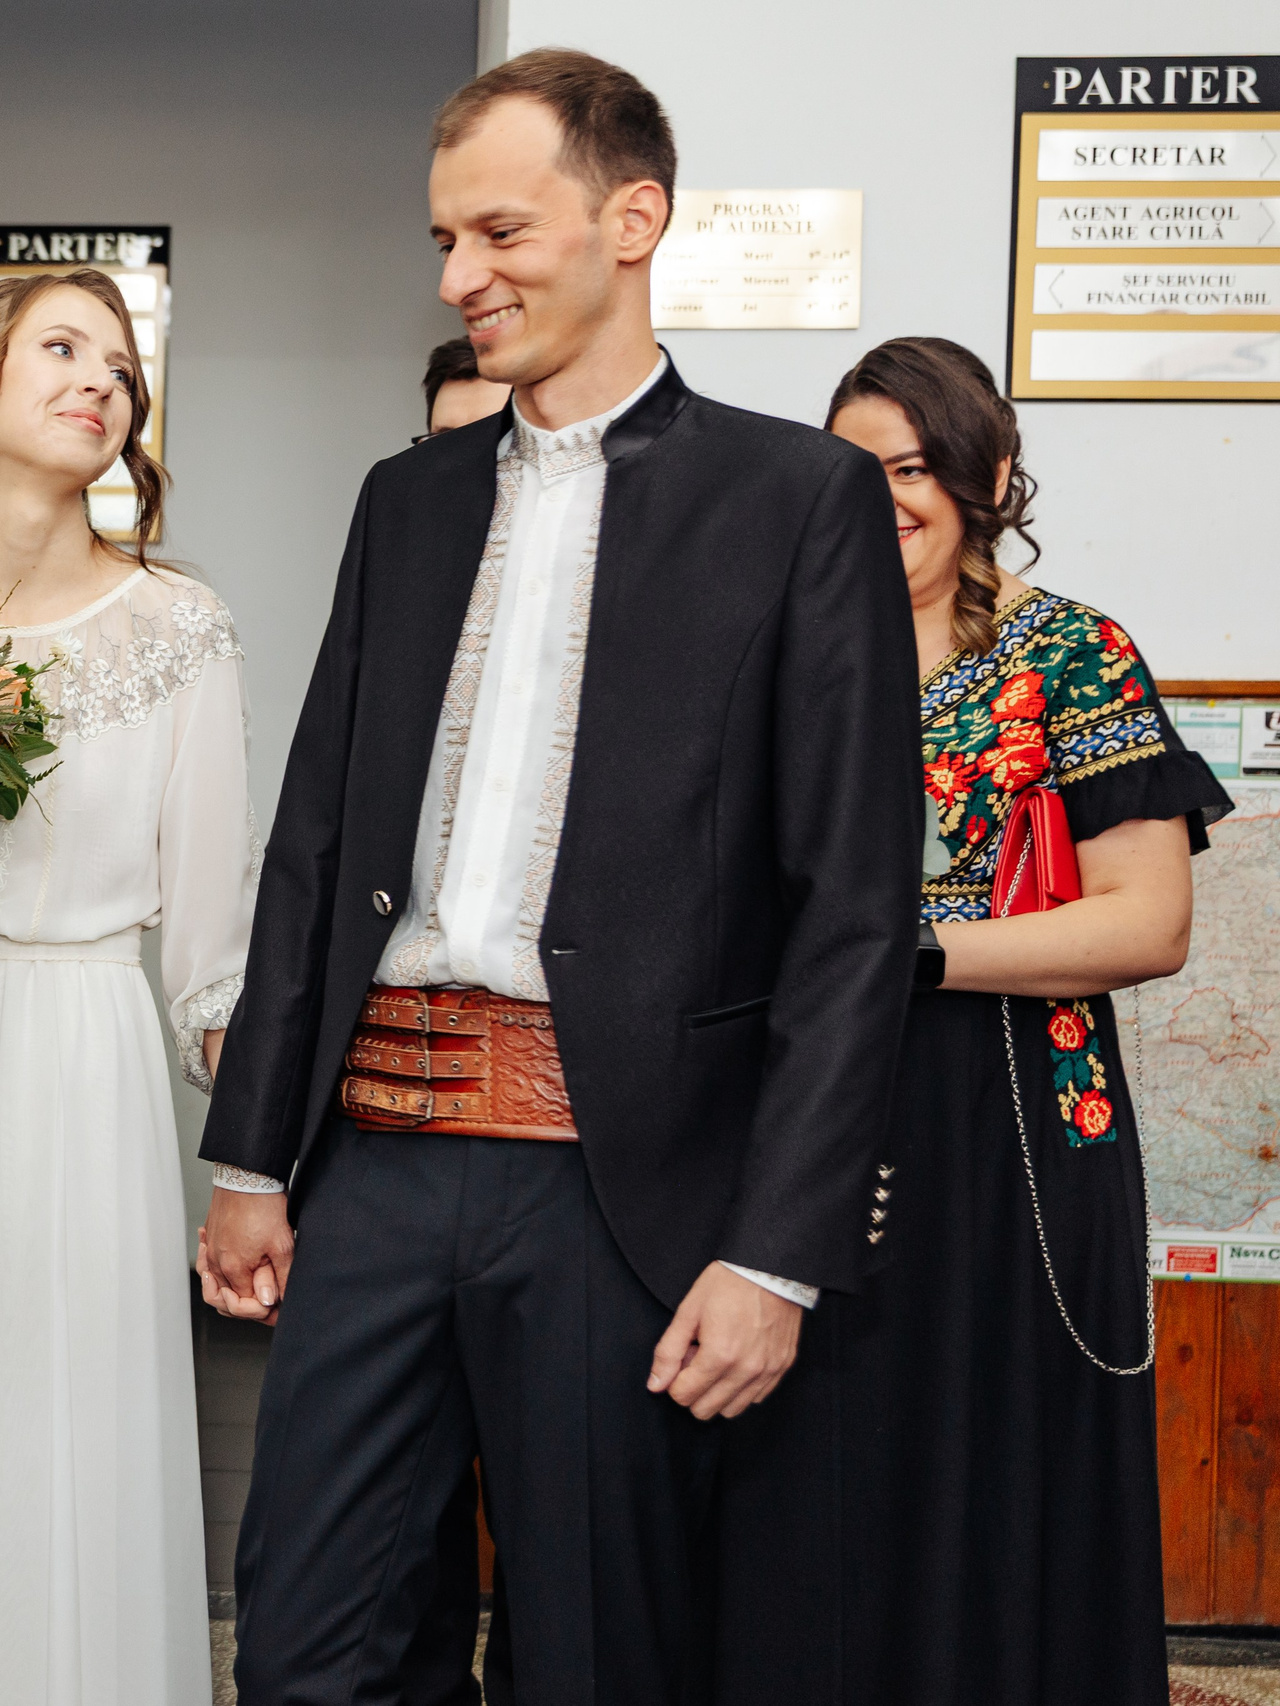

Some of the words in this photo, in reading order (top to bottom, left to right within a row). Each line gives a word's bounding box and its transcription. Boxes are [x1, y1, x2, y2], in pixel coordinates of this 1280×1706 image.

[1051, 65, 1261, 105] PARTER
[1073, 144, 1228, 167] SECRETAR
[1058, 205, 1132, 222] AGENT
[1140, 205, 1241, 222] AGRICOL
[1071, 225, 1139, 241] STARE
[1156, 273, 1237, 288] SERVICIU
[1086, 290, 1181, 306] FINANCIAR
[1185, 290, 1272, 306] CONTABIL
